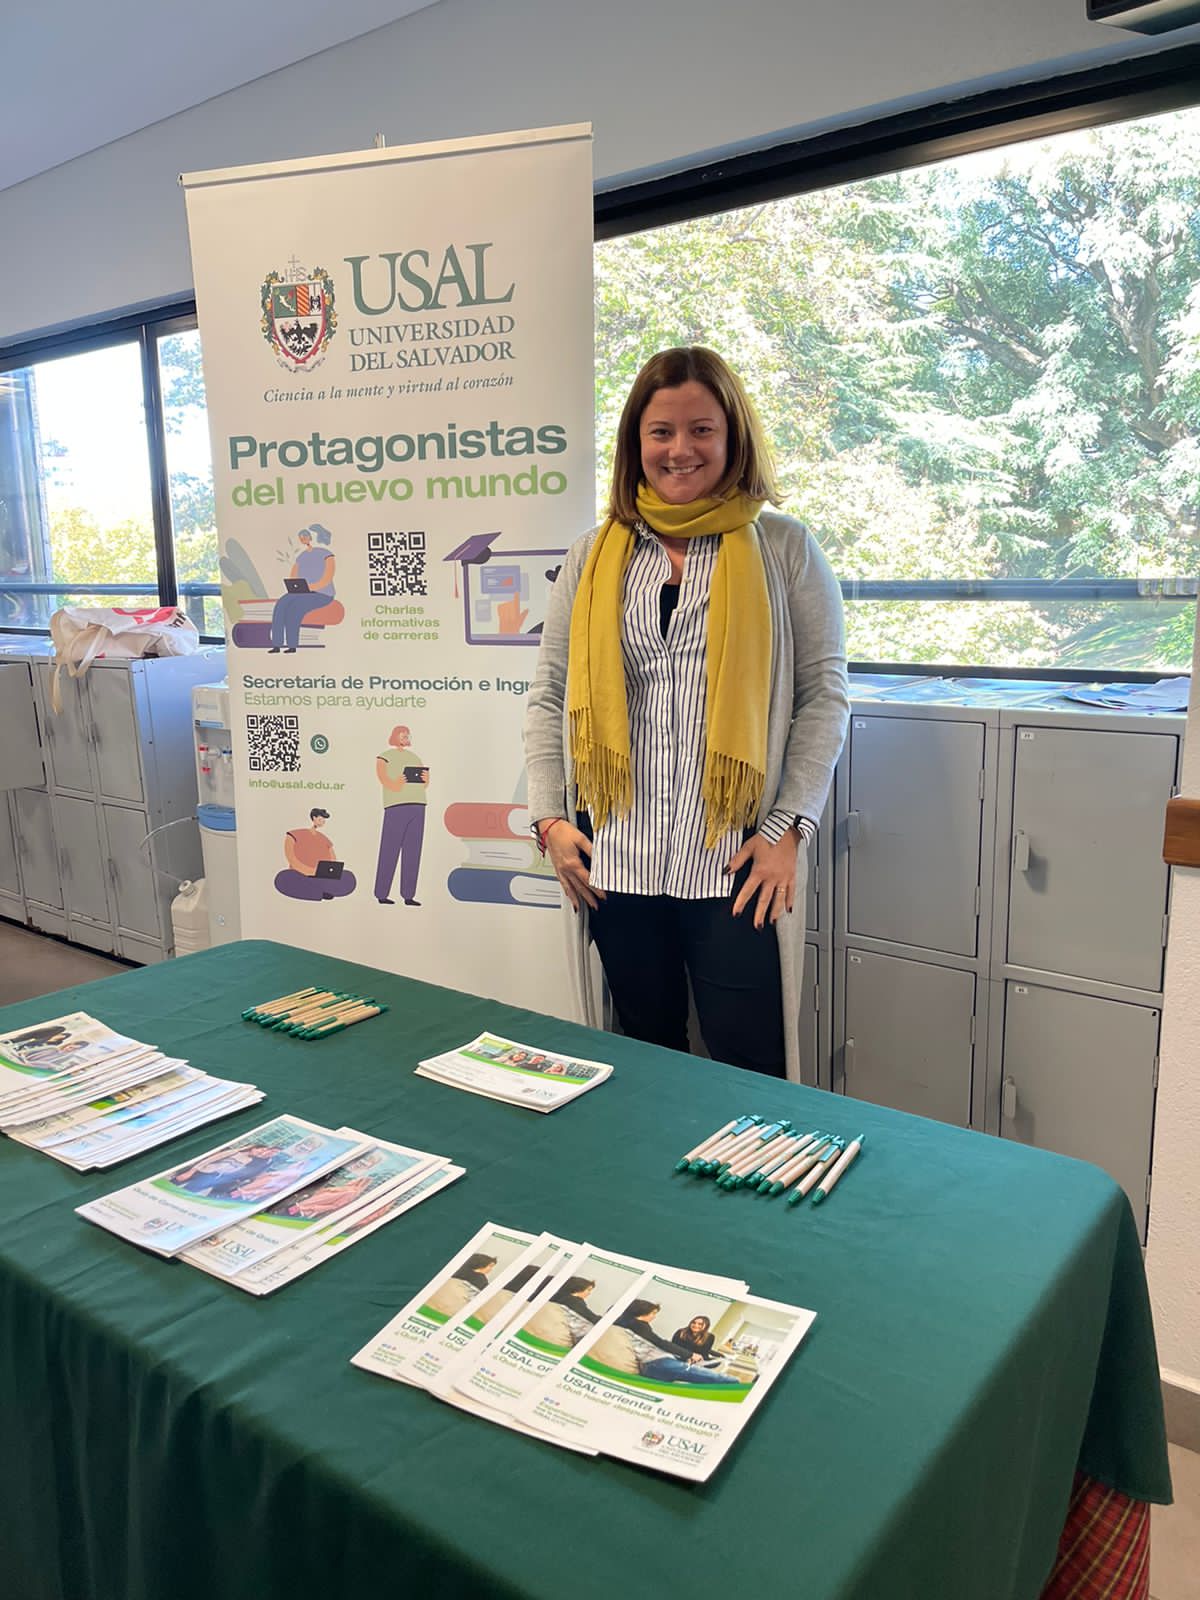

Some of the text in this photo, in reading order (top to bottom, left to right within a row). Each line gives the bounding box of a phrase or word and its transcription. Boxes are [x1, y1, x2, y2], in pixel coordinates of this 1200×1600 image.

[344, 242, 515, 316] USAL
[349, 315, 515, 346] UNIVERSIDAD
[350, 341, 516, 372] DEL SALVADOR
[263, 371, 513, 403] Ciencia a la mente y virtud al corazón
[228, 420, 568, 473] Protagonistas
[231, 464, 568, 507] del nuevo mundo
[375, 604, 424, 616] Charlas
[360, 617, 440, 628] informativas
[363, 629, 439, 641] de carreras
[243, 674, 529, 695] Secretaría de Promoción e Ingr
[244, 692, 427, 711] Estamos para ayudarte
[248, 779, 345, 790] info@usal.edu.ar
[500, 1345, 534, 1367] USAL
[563, 1374, 598, 1395] USAL
[602, 1390, 653, 1412] orienta
[656, 1407, 671, 1417] tu
[674, 1412, 722, 1431] futuro.
[667, 1435, 708, 1456] USAL
